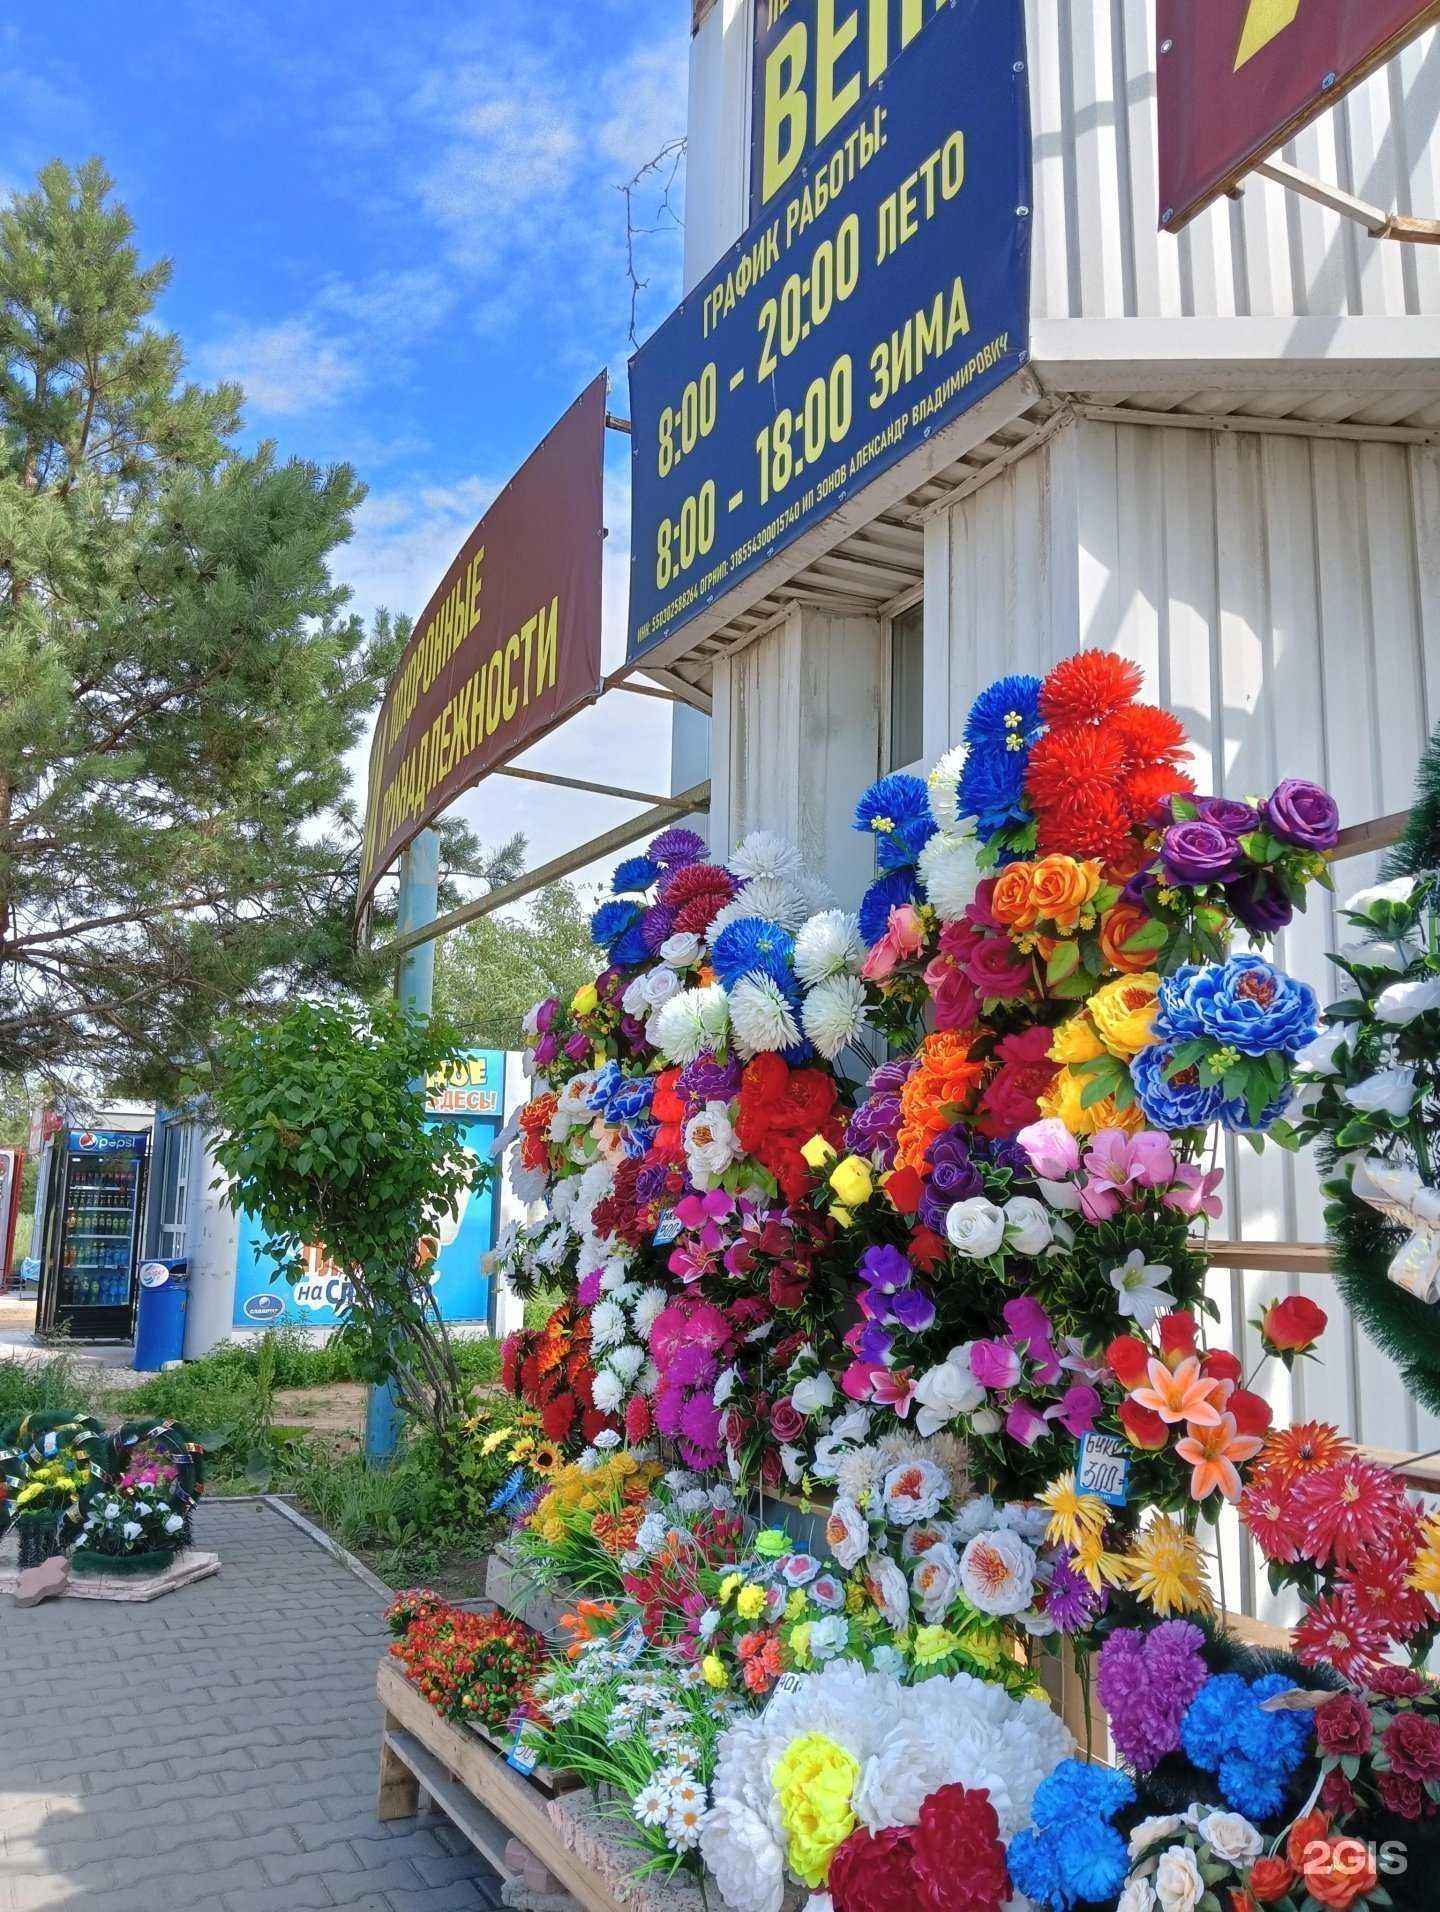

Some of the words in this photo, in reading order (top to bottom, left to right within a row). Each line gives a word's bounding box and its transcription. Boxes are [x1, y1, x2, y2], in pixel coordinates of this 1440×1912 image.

[657, 361, 717, 479] 8:00
[757, 212, 859, 384] 20:00
[876, 129, 965, 266] ЛЕТО
[701, 219, 780, 340] ГРАФИК
[786, 104, 887, 248] РАБОТЫ:
[656, 478, 716, 590] 8:00
[756, 353, 852, 506] 18:00
[869, 275, 971, 410] ЗИМА
[700, 560, 729, 595] ОГРНИП:
[802, 489, 814, 515] ИП
[816, 464, 847, 503] ЗОНОВ
[849, 413, 909, 479] АЛЕКСАНДР
[912, 331, 1009, 427] ВЛАДИМИРОВИЧ
[378, 596, 559, 855] ПРИНАДЛЕЖНОСТИ
[298, 1285, 323, 1300] на
